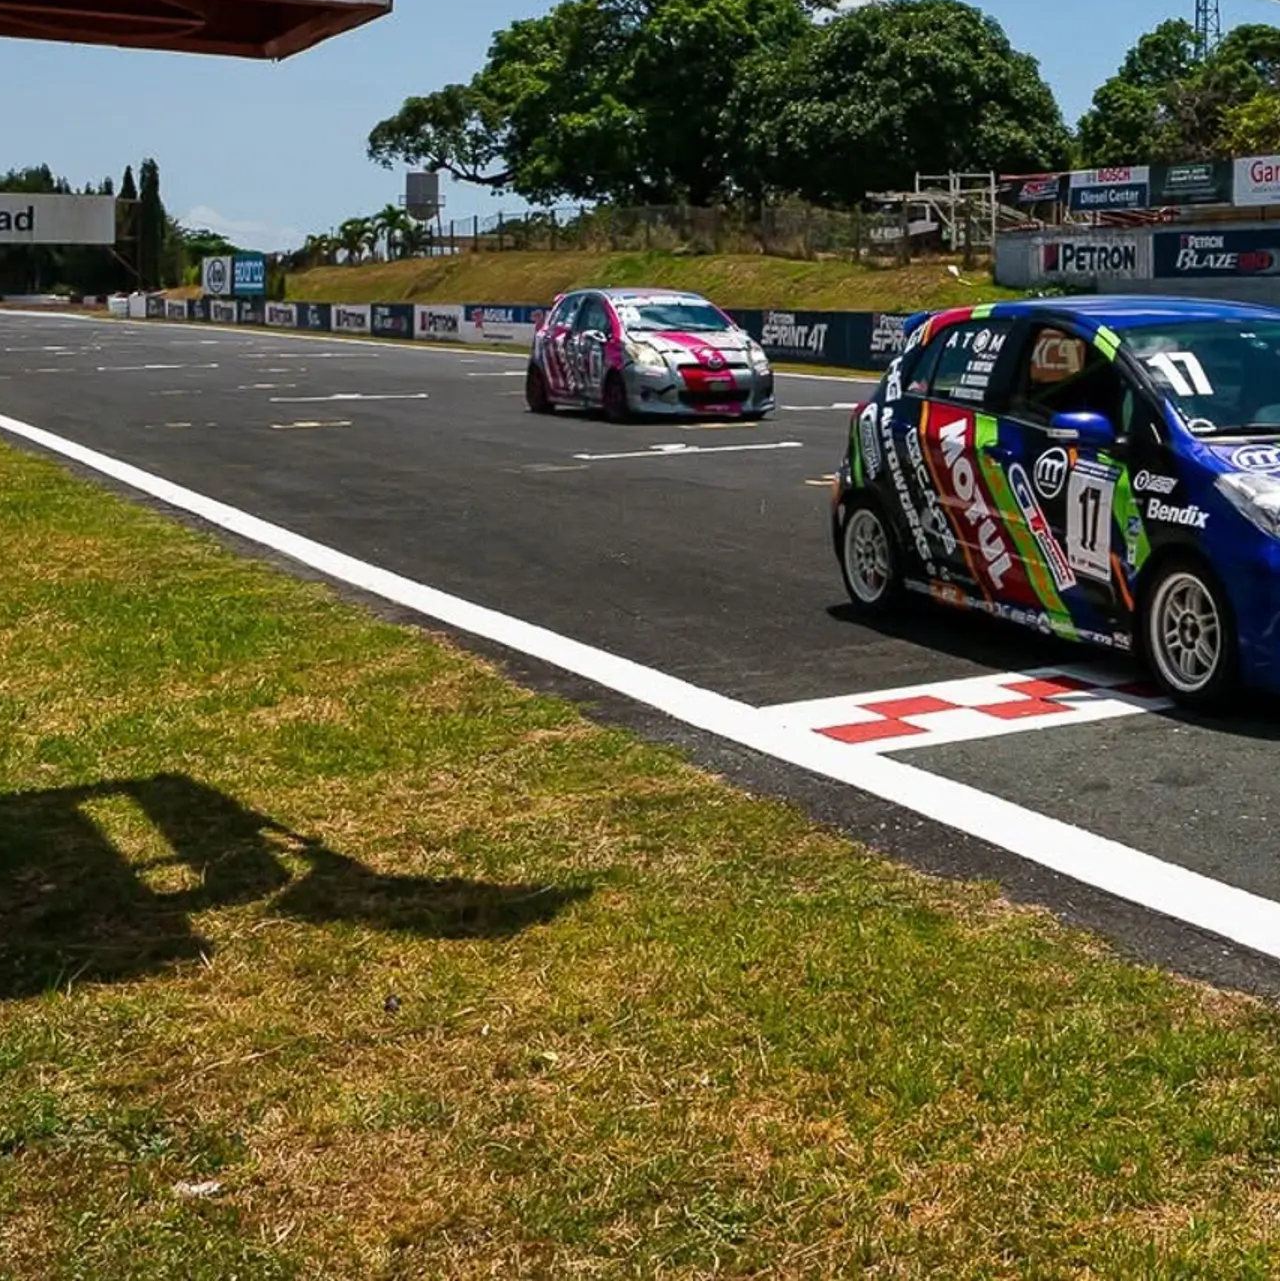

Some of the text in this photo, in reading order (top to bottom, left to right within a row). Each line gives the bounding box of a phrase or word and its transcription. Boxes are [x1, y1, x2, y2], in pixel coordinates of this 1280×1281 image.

[1062, 243, 1136, 271] PETRON
[761, 324, 809, 348] SPRINT
[1146, 351, 1214, 396] 17
[939, 417, 1013, 590] MOTUL
[1079, 486, 1102, 551] 17
[1147, 498, 1210, 529] Bendix
